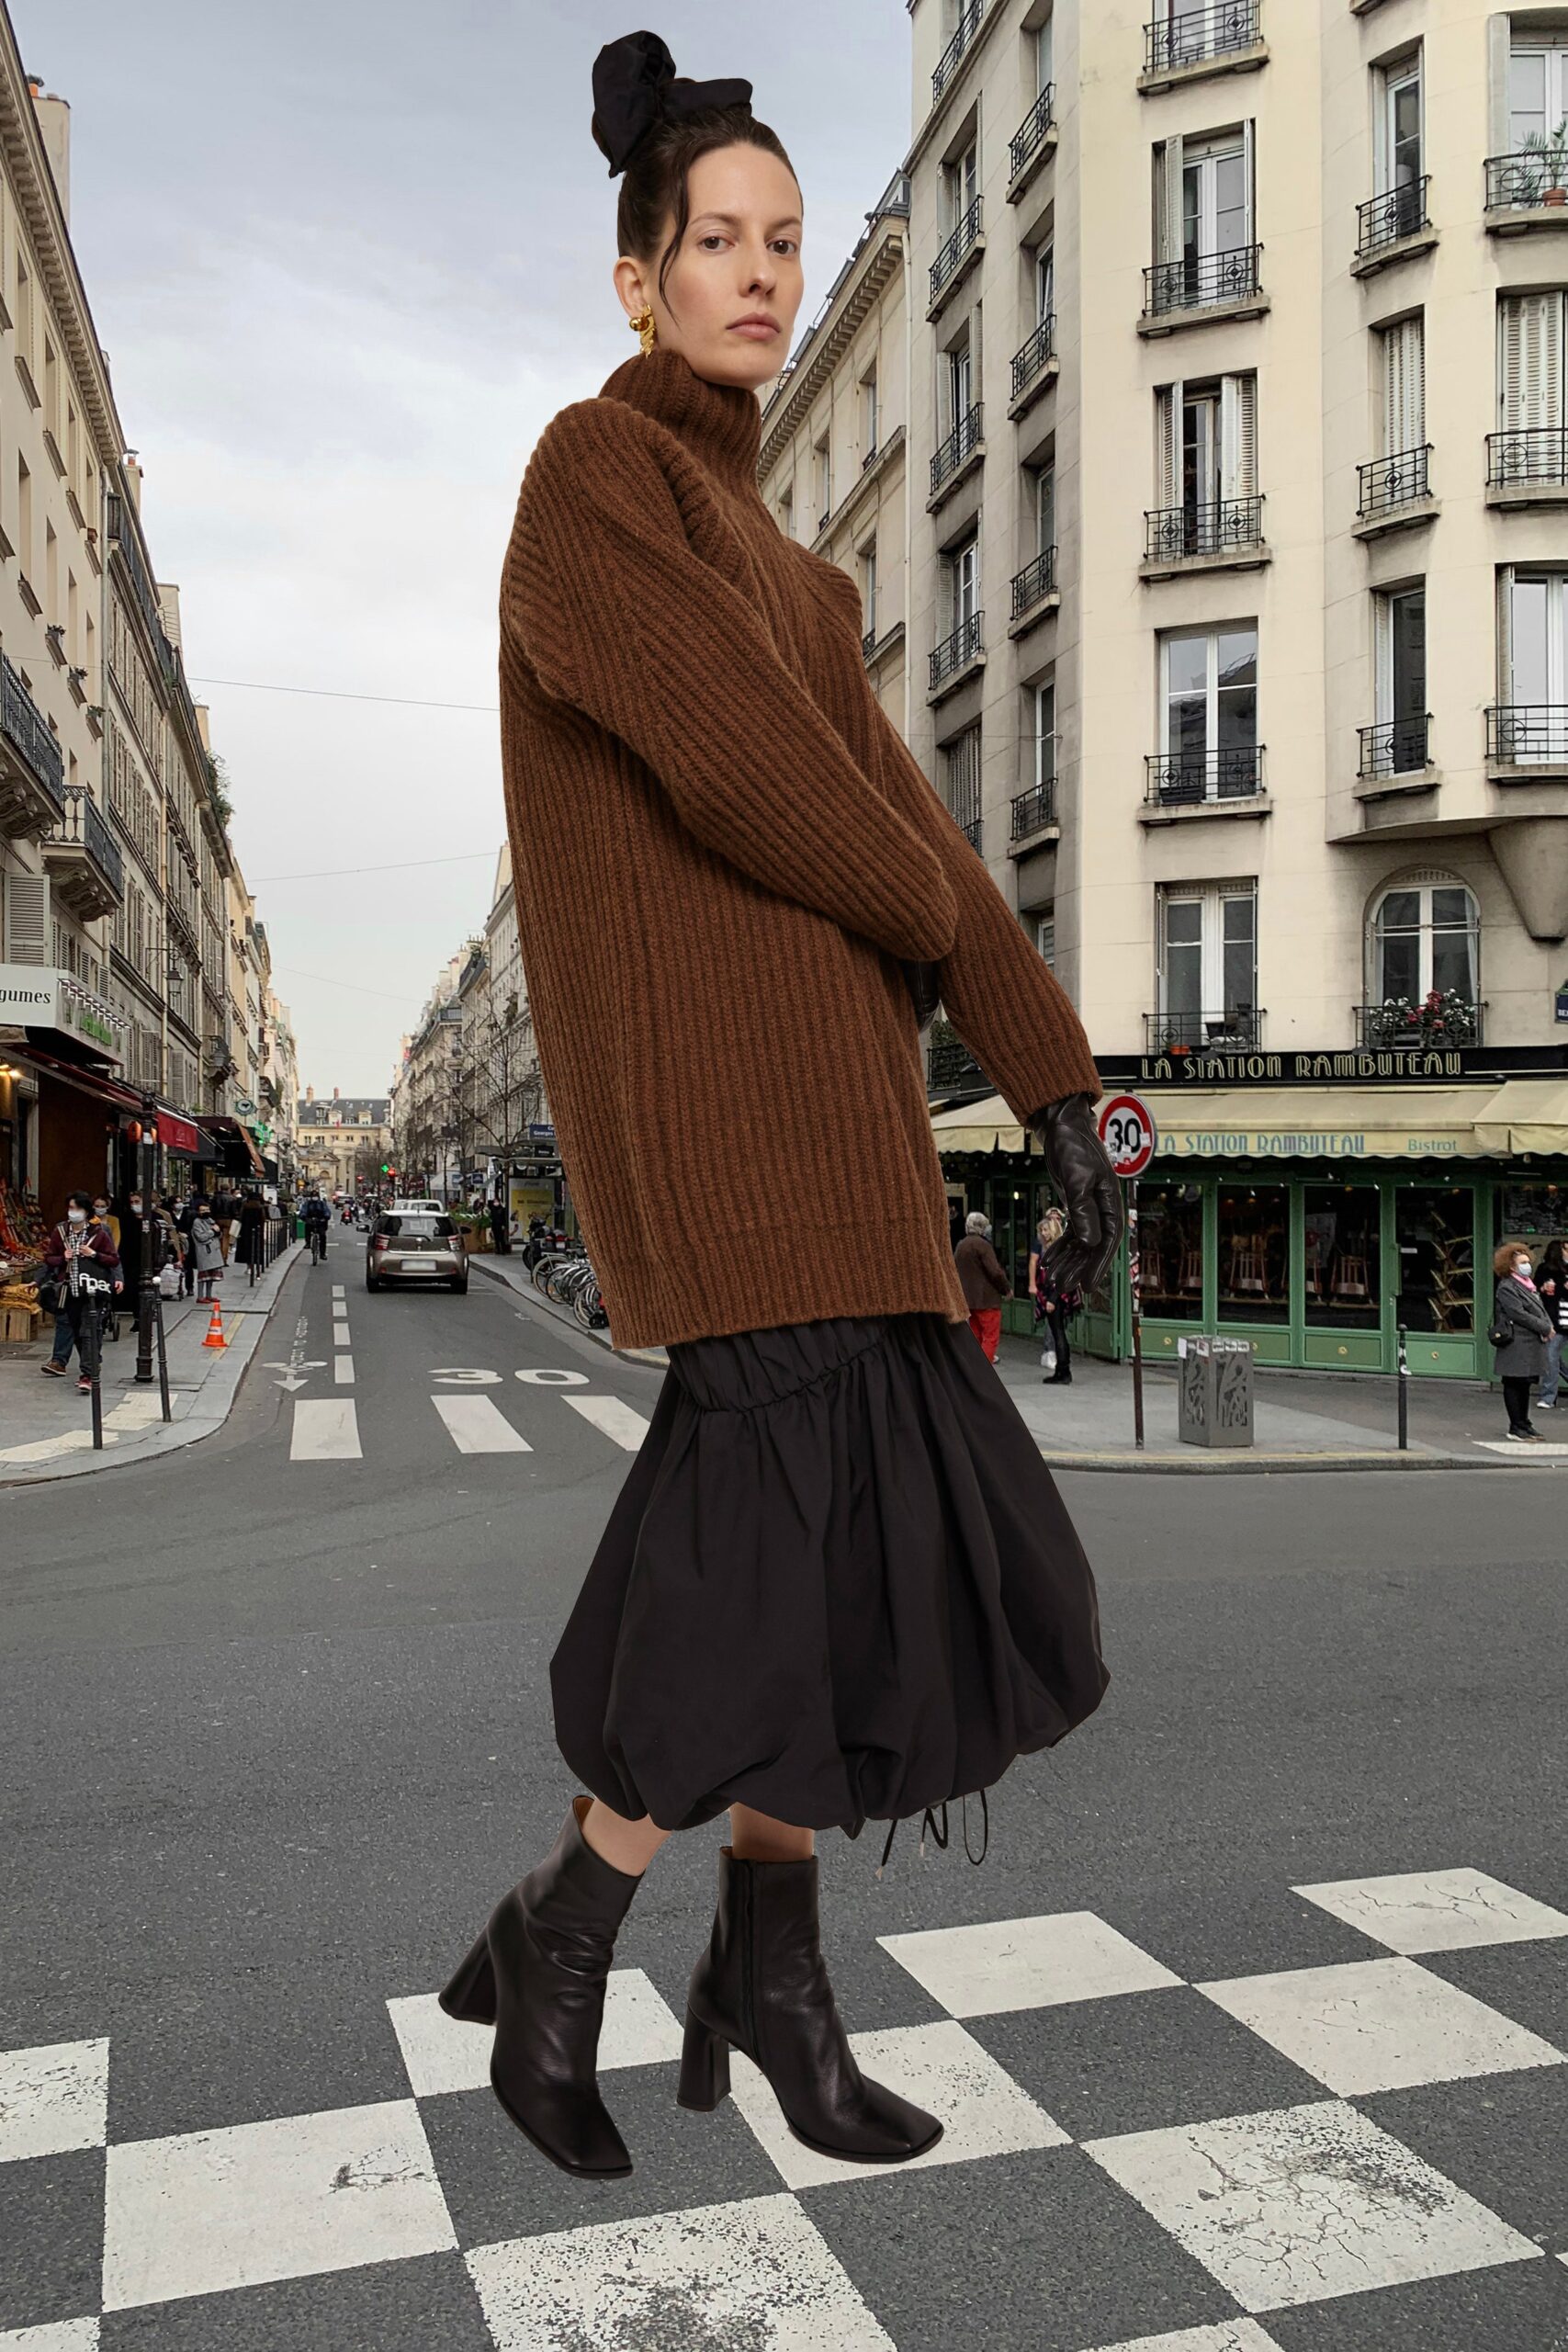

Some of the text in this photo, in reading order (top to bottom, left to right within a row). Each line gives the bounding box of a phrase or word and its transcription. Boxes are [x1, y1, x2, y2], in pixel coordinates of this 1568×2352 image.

[1142, 1052, 1461, 1080] LA STATION RAMBUTEAU
[1109, 1118, 1141, 1153] 30
[1186, 1134, 1247, 1153] STATION
[1258, 1134, 1364, 1154] RAMBUTEAU
[1408, 1139, 1457, 1152] Bistrot
